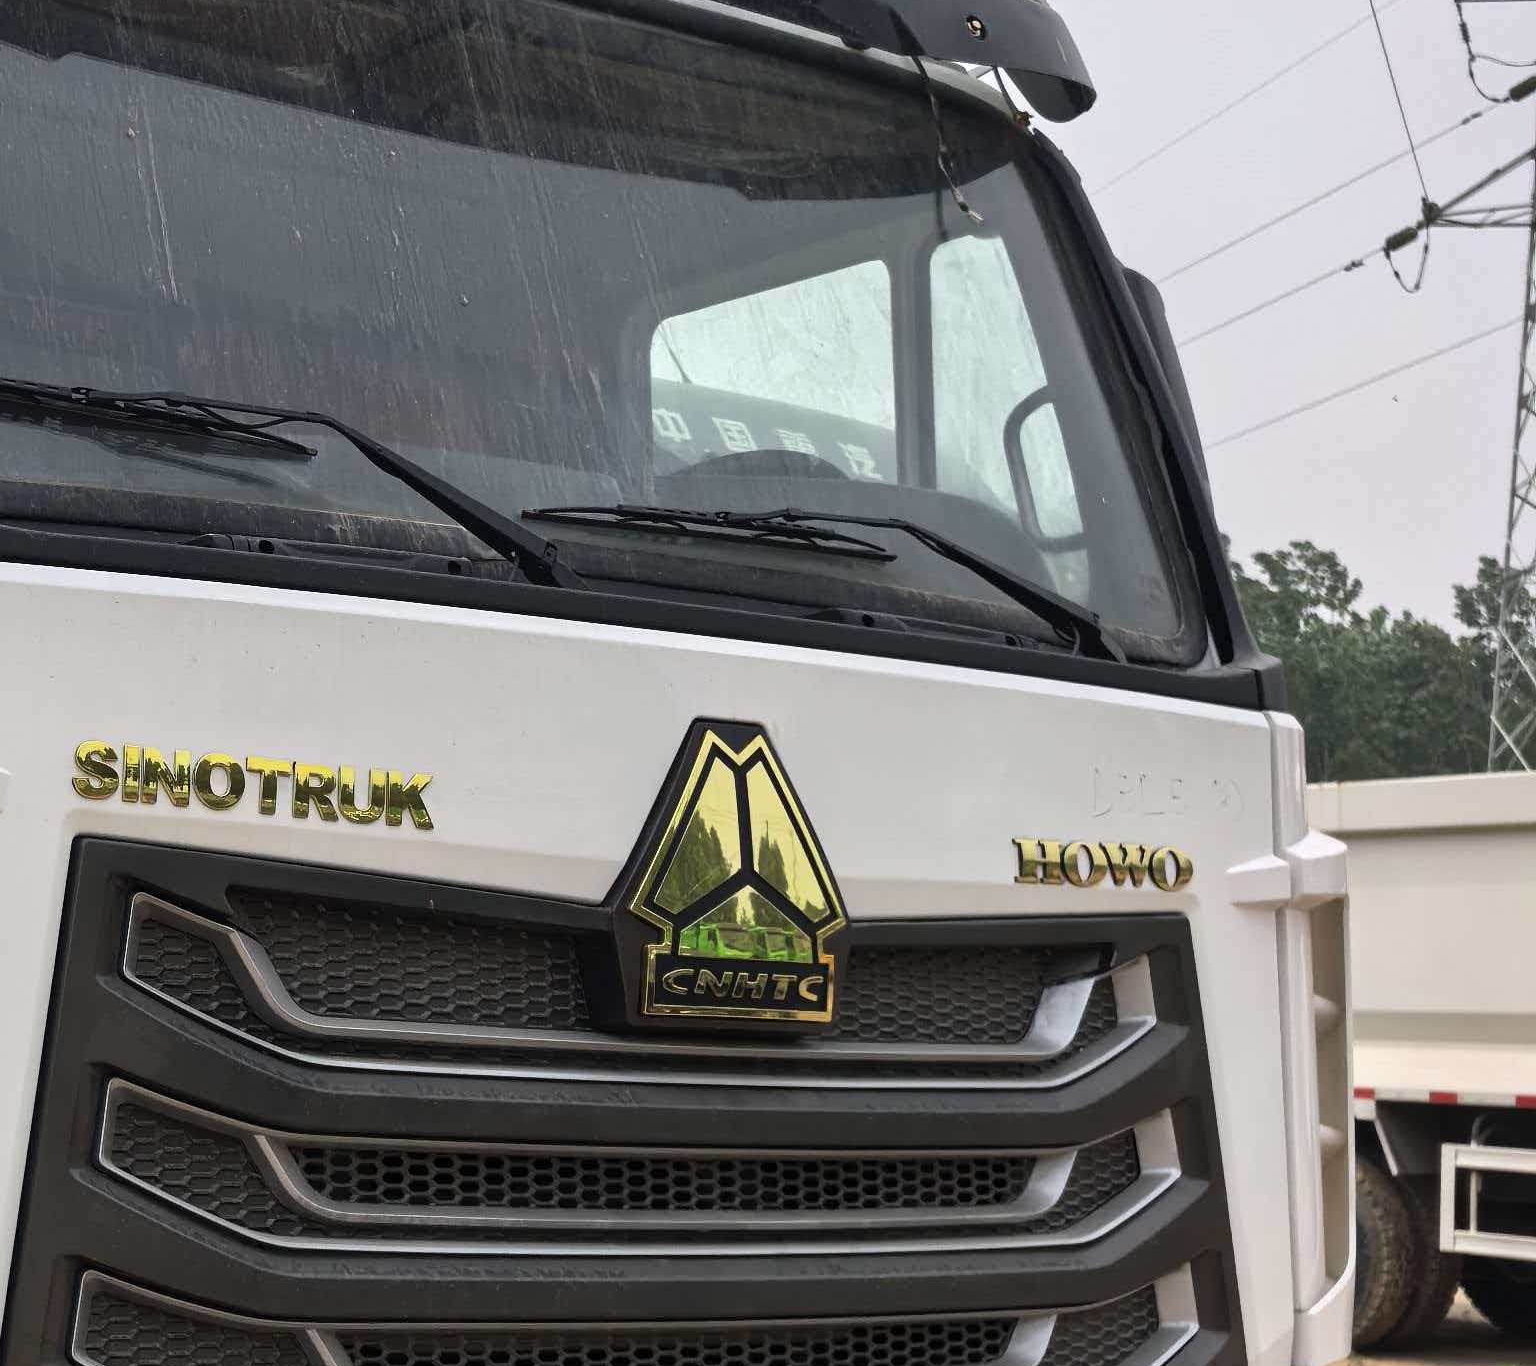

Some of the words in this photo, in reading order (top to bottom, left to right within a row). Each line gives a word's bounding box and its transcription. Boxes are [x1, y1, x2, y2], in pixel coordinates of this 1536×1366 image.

[71, 739, 434, 830] SINOTRUK
[1012, 838, 1194, 892] HOWO
[662, 968, 824, 1002] CNHTC
